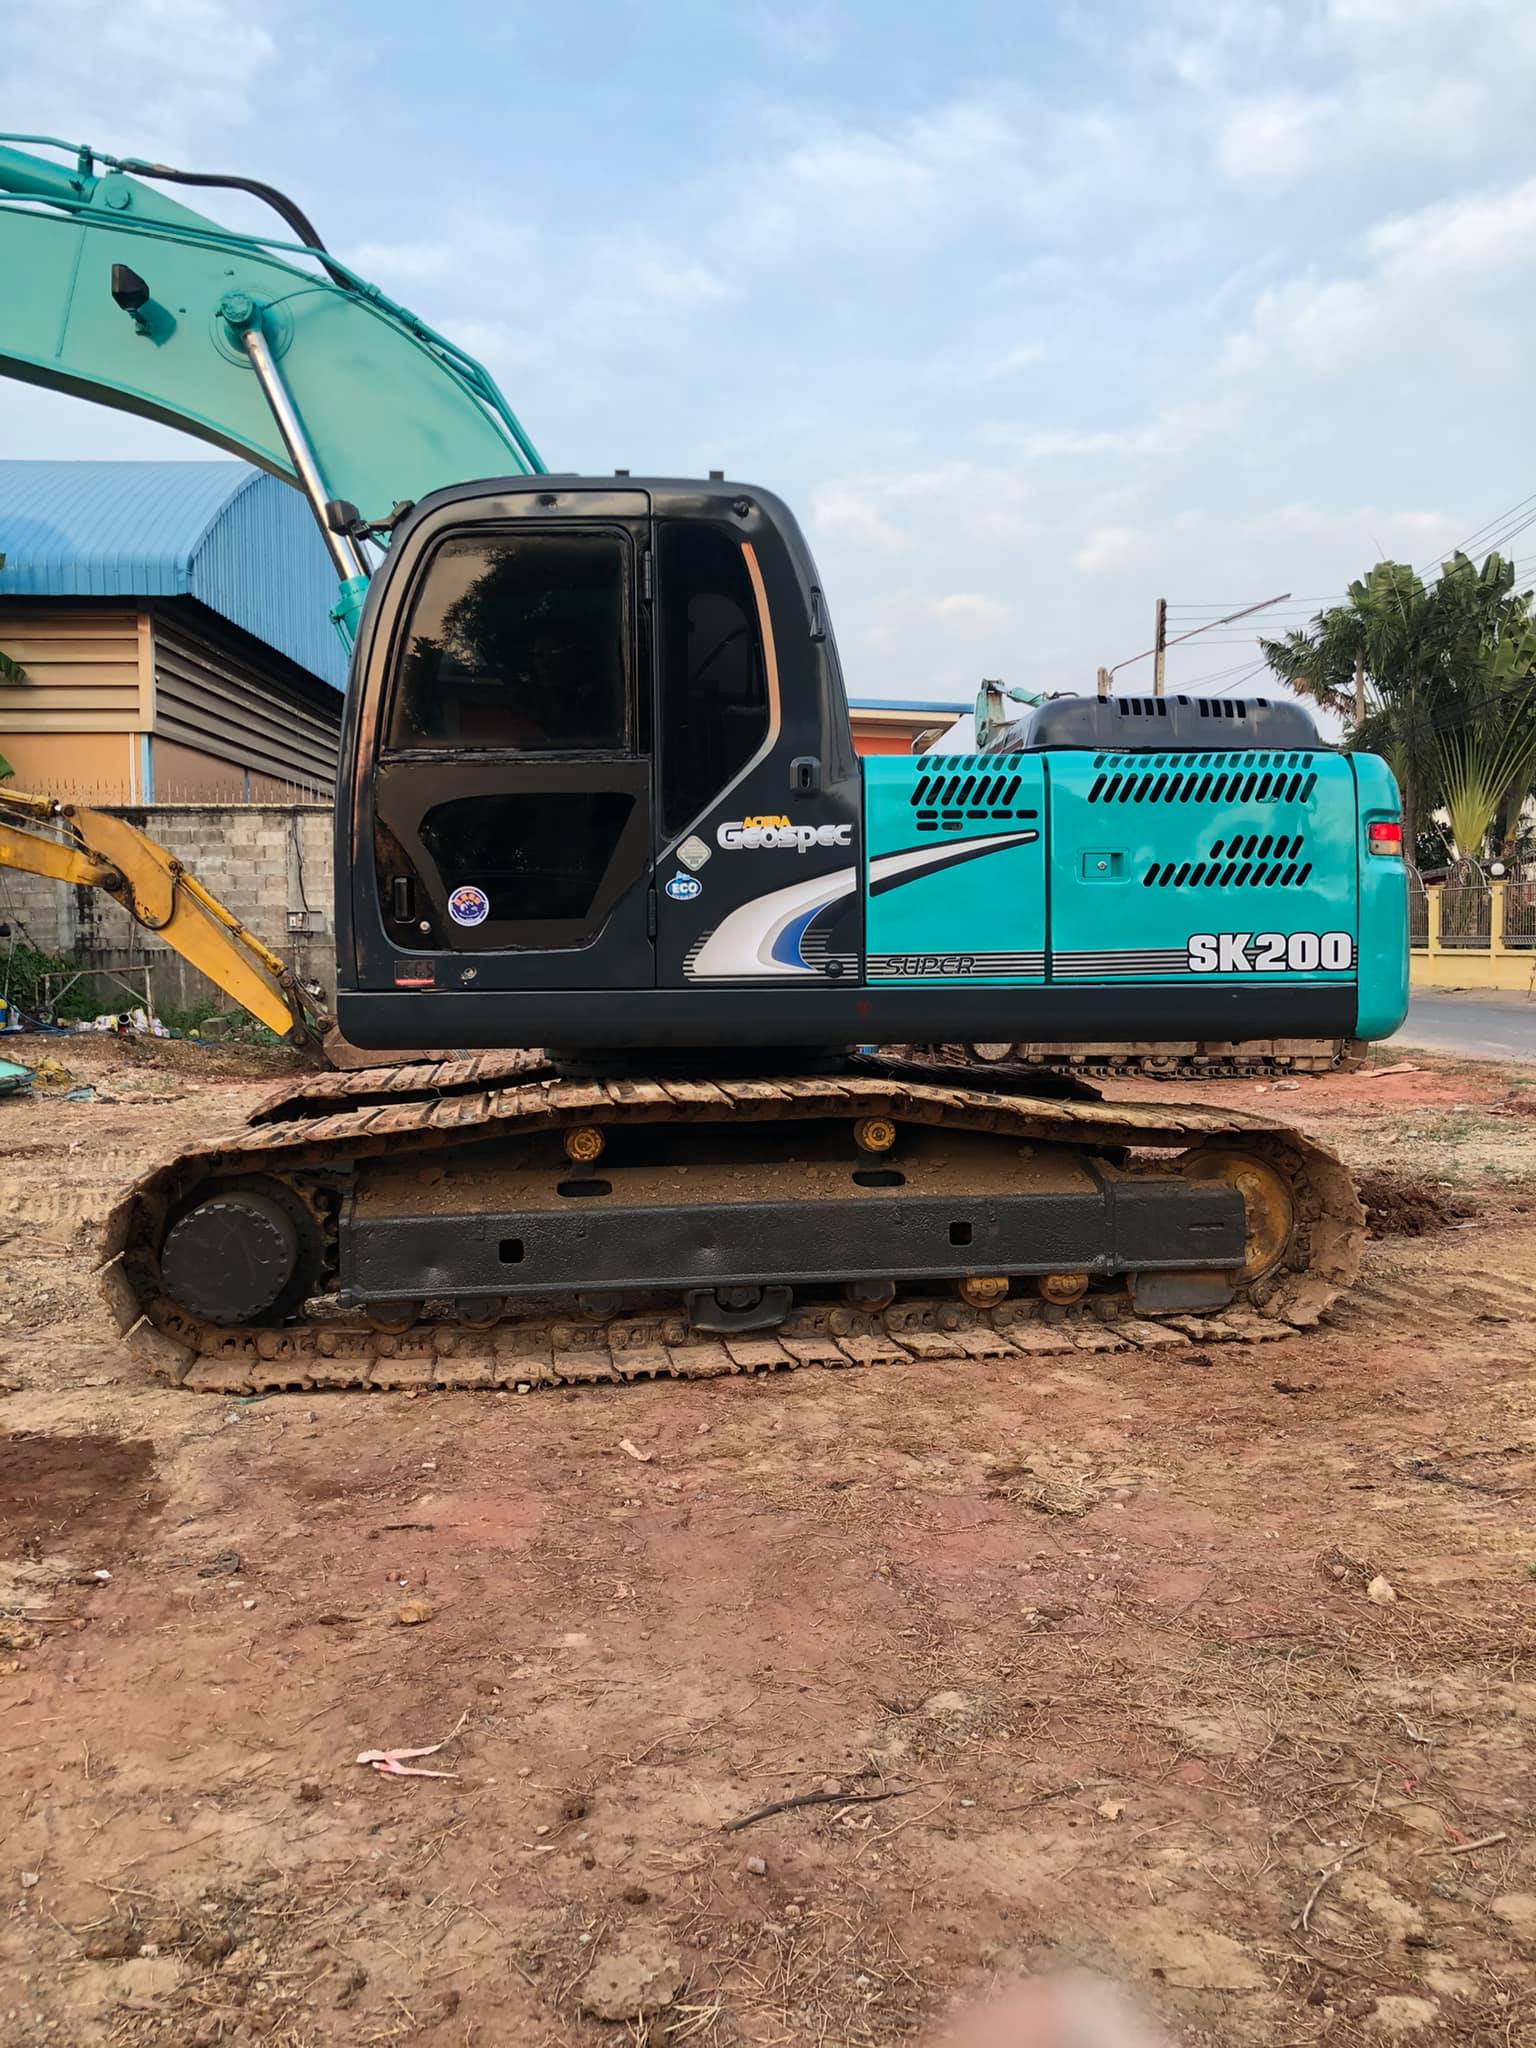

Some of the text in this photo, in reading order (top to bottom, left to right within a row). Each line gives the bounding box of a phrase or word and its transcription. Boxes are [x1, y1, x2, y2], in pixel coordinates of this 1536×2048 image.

[671, 882, 699, 893] ECO
[1187, 931, 1352, 972] SK200
[885, 956, 976, 976] SUPER
